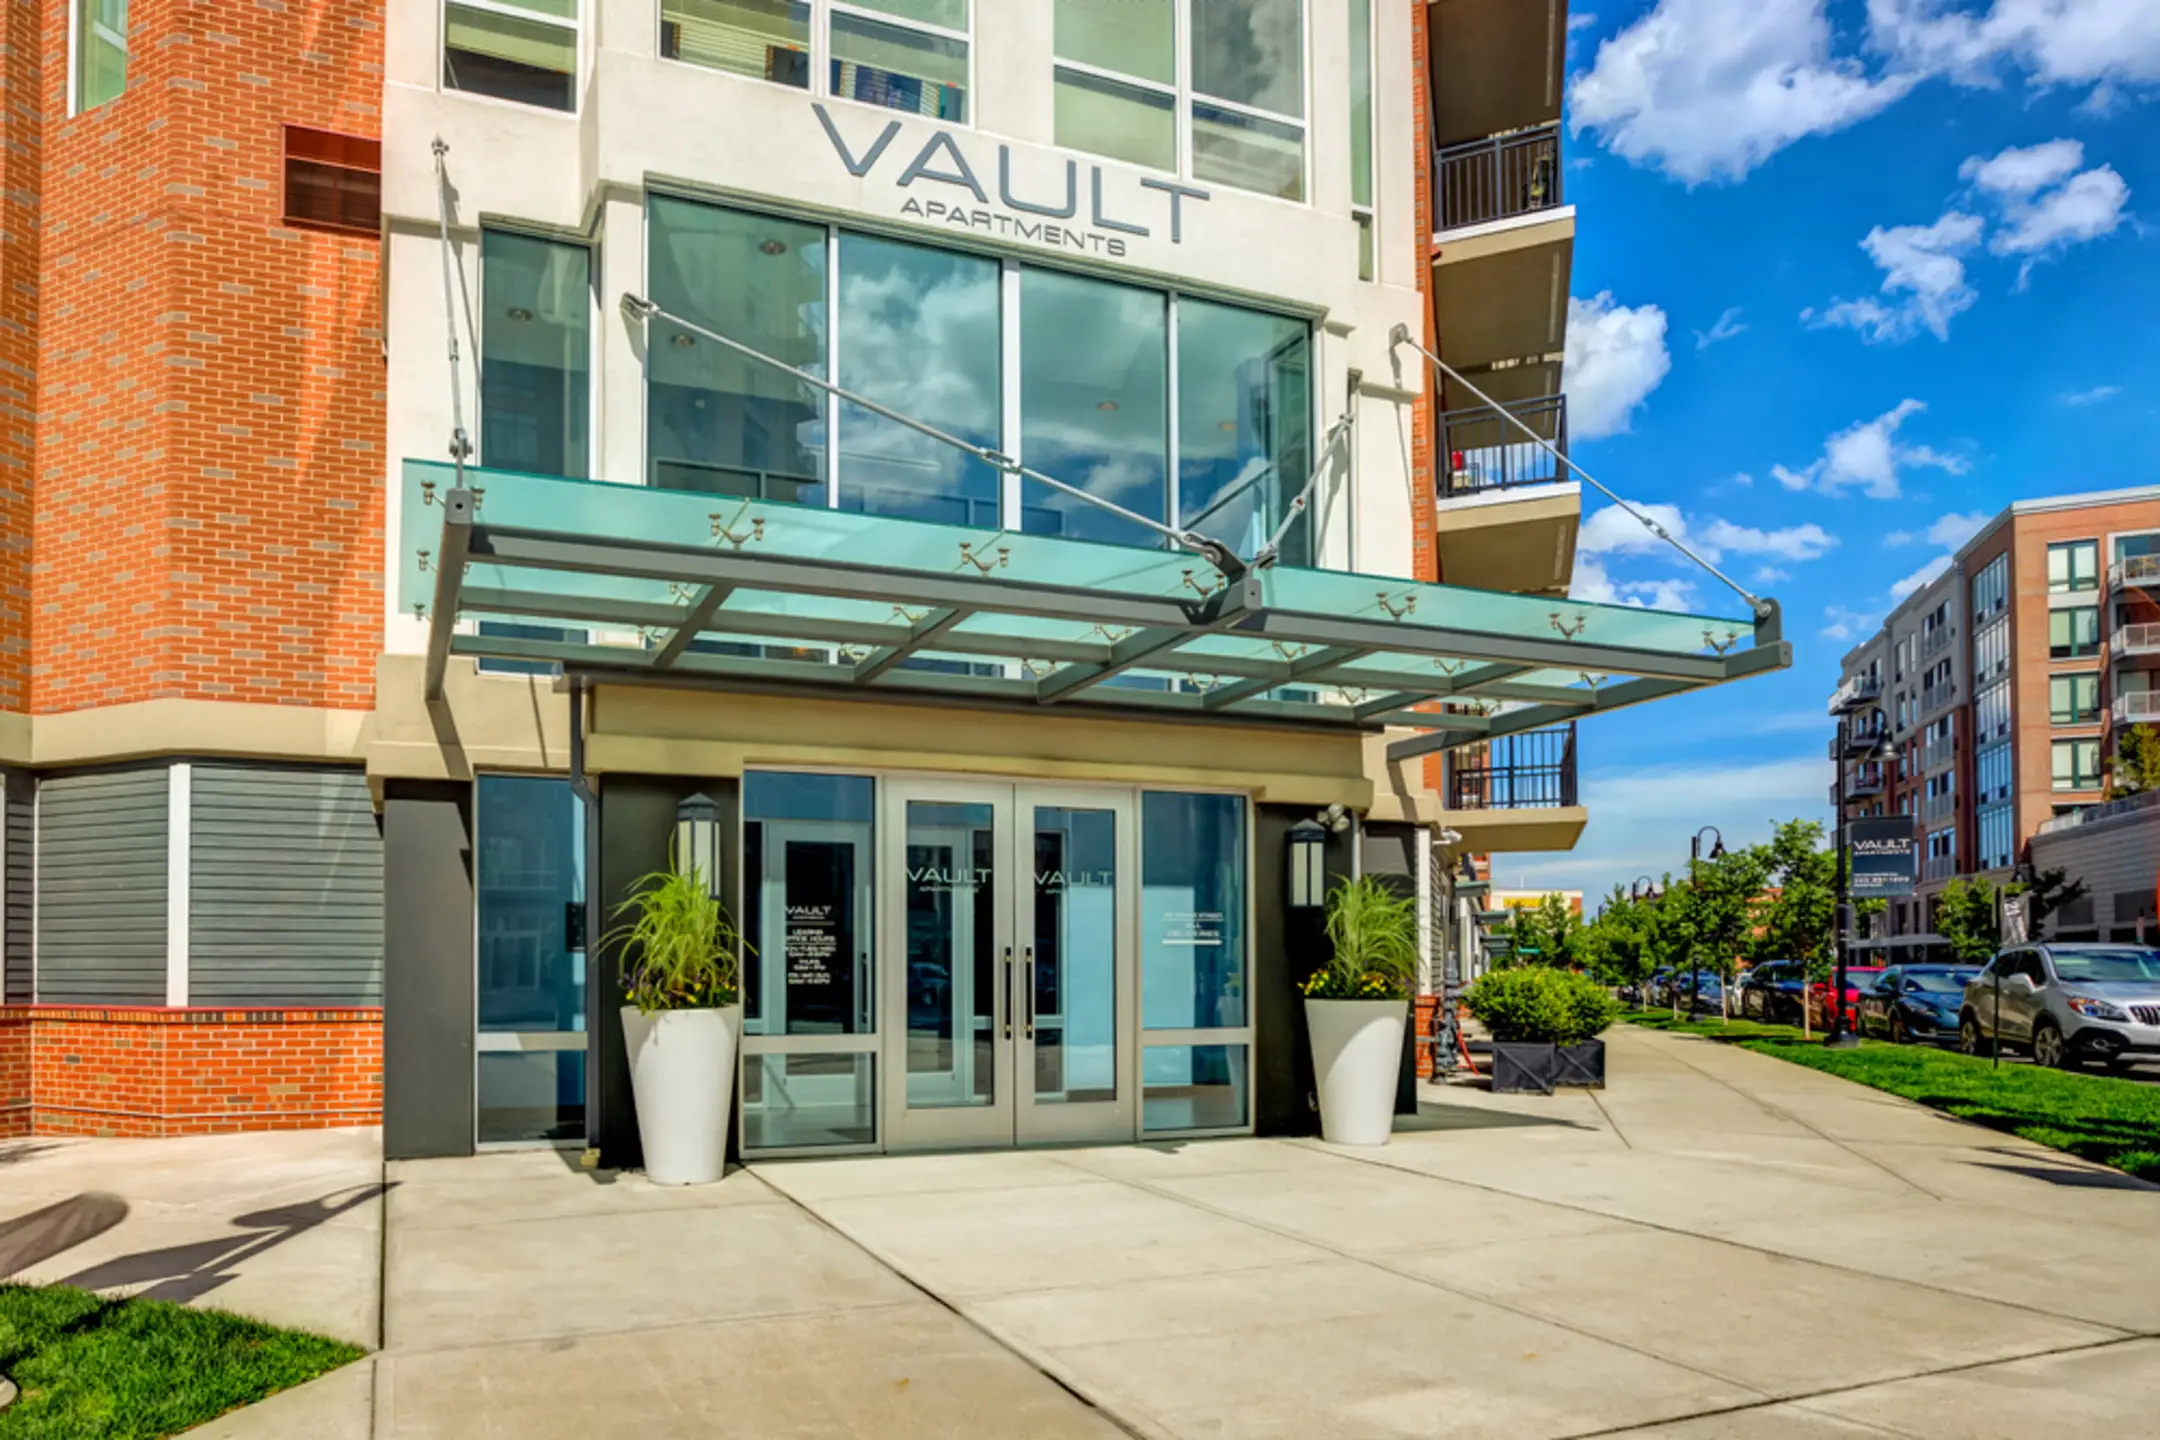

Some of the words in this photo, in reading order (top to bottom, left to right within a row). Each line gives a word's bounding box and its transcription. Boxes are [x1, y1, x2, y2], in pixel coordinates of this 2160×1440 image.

[811, 102, 1210, 244] VAULT
[900, 197, 1126, 257] APARTMENTS
[1853, 838, 1910, 850] VAULT
[906, 866, 992, 884] VAULT
[1033, 870, 1113, 886] VAULT
[784, 905, 832, 915] VAULT
